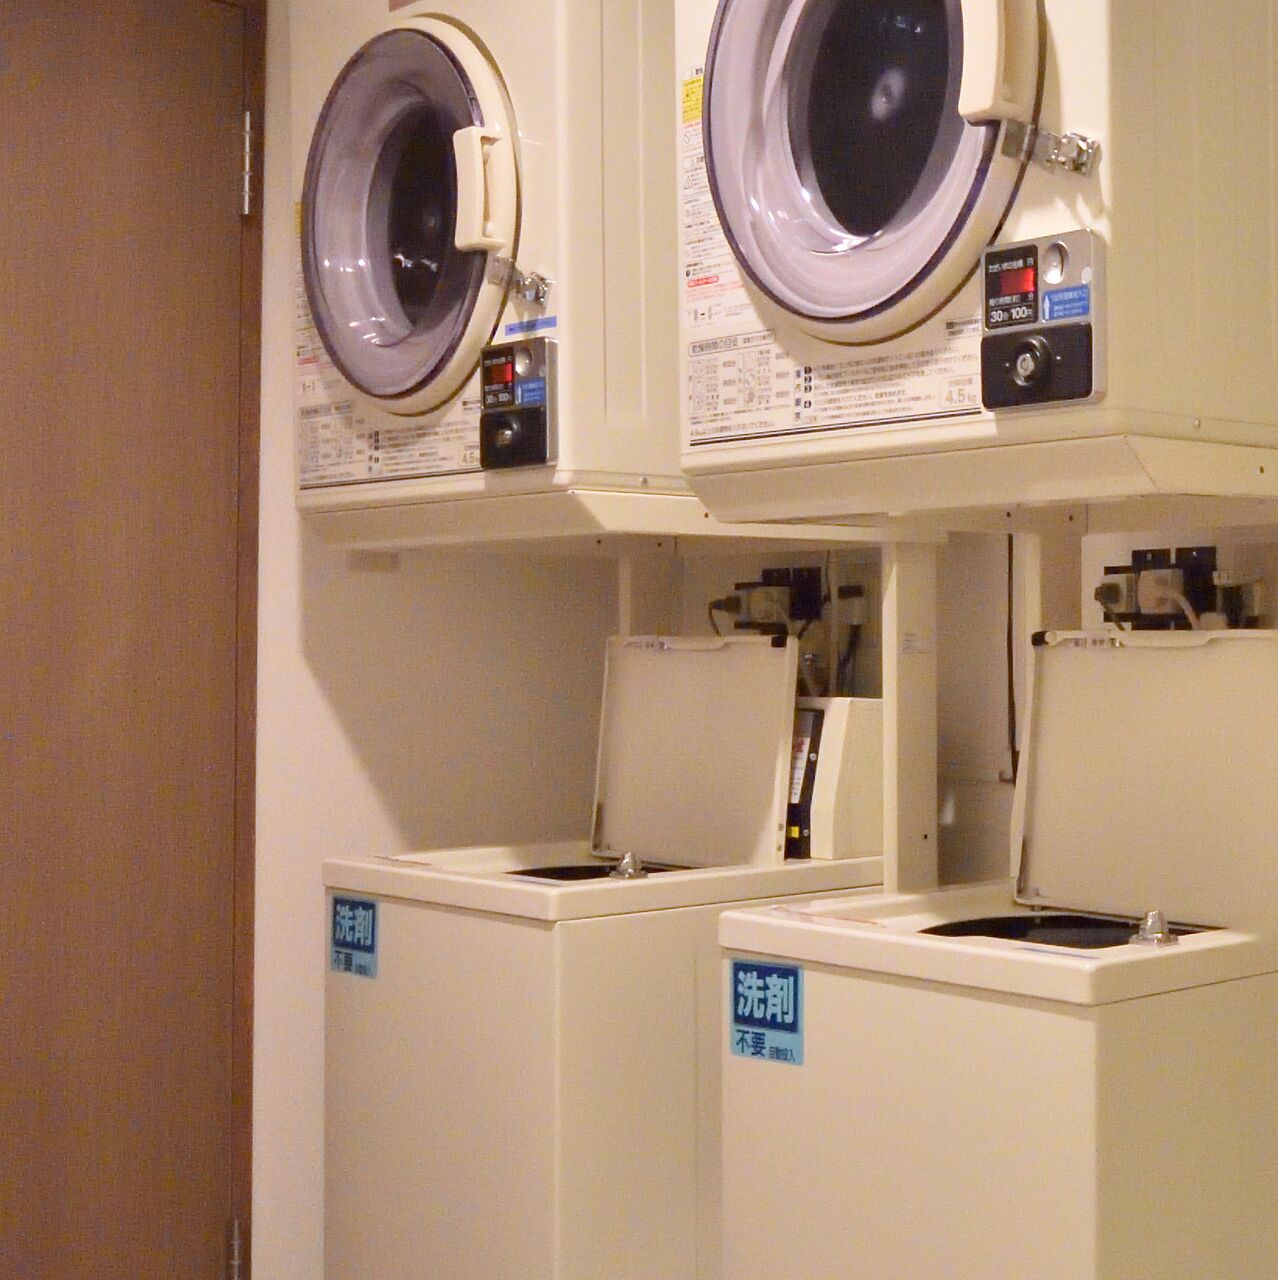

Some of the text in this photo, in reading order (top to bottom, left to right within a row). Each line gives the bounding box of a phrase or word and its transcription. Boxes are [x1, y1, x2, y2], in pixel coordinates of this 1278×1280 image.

[336, 905, 372, 945] 洗剤
[737, 970, 794, 1024] 洗剤
[736, 1029, 766, 1057] 不要
